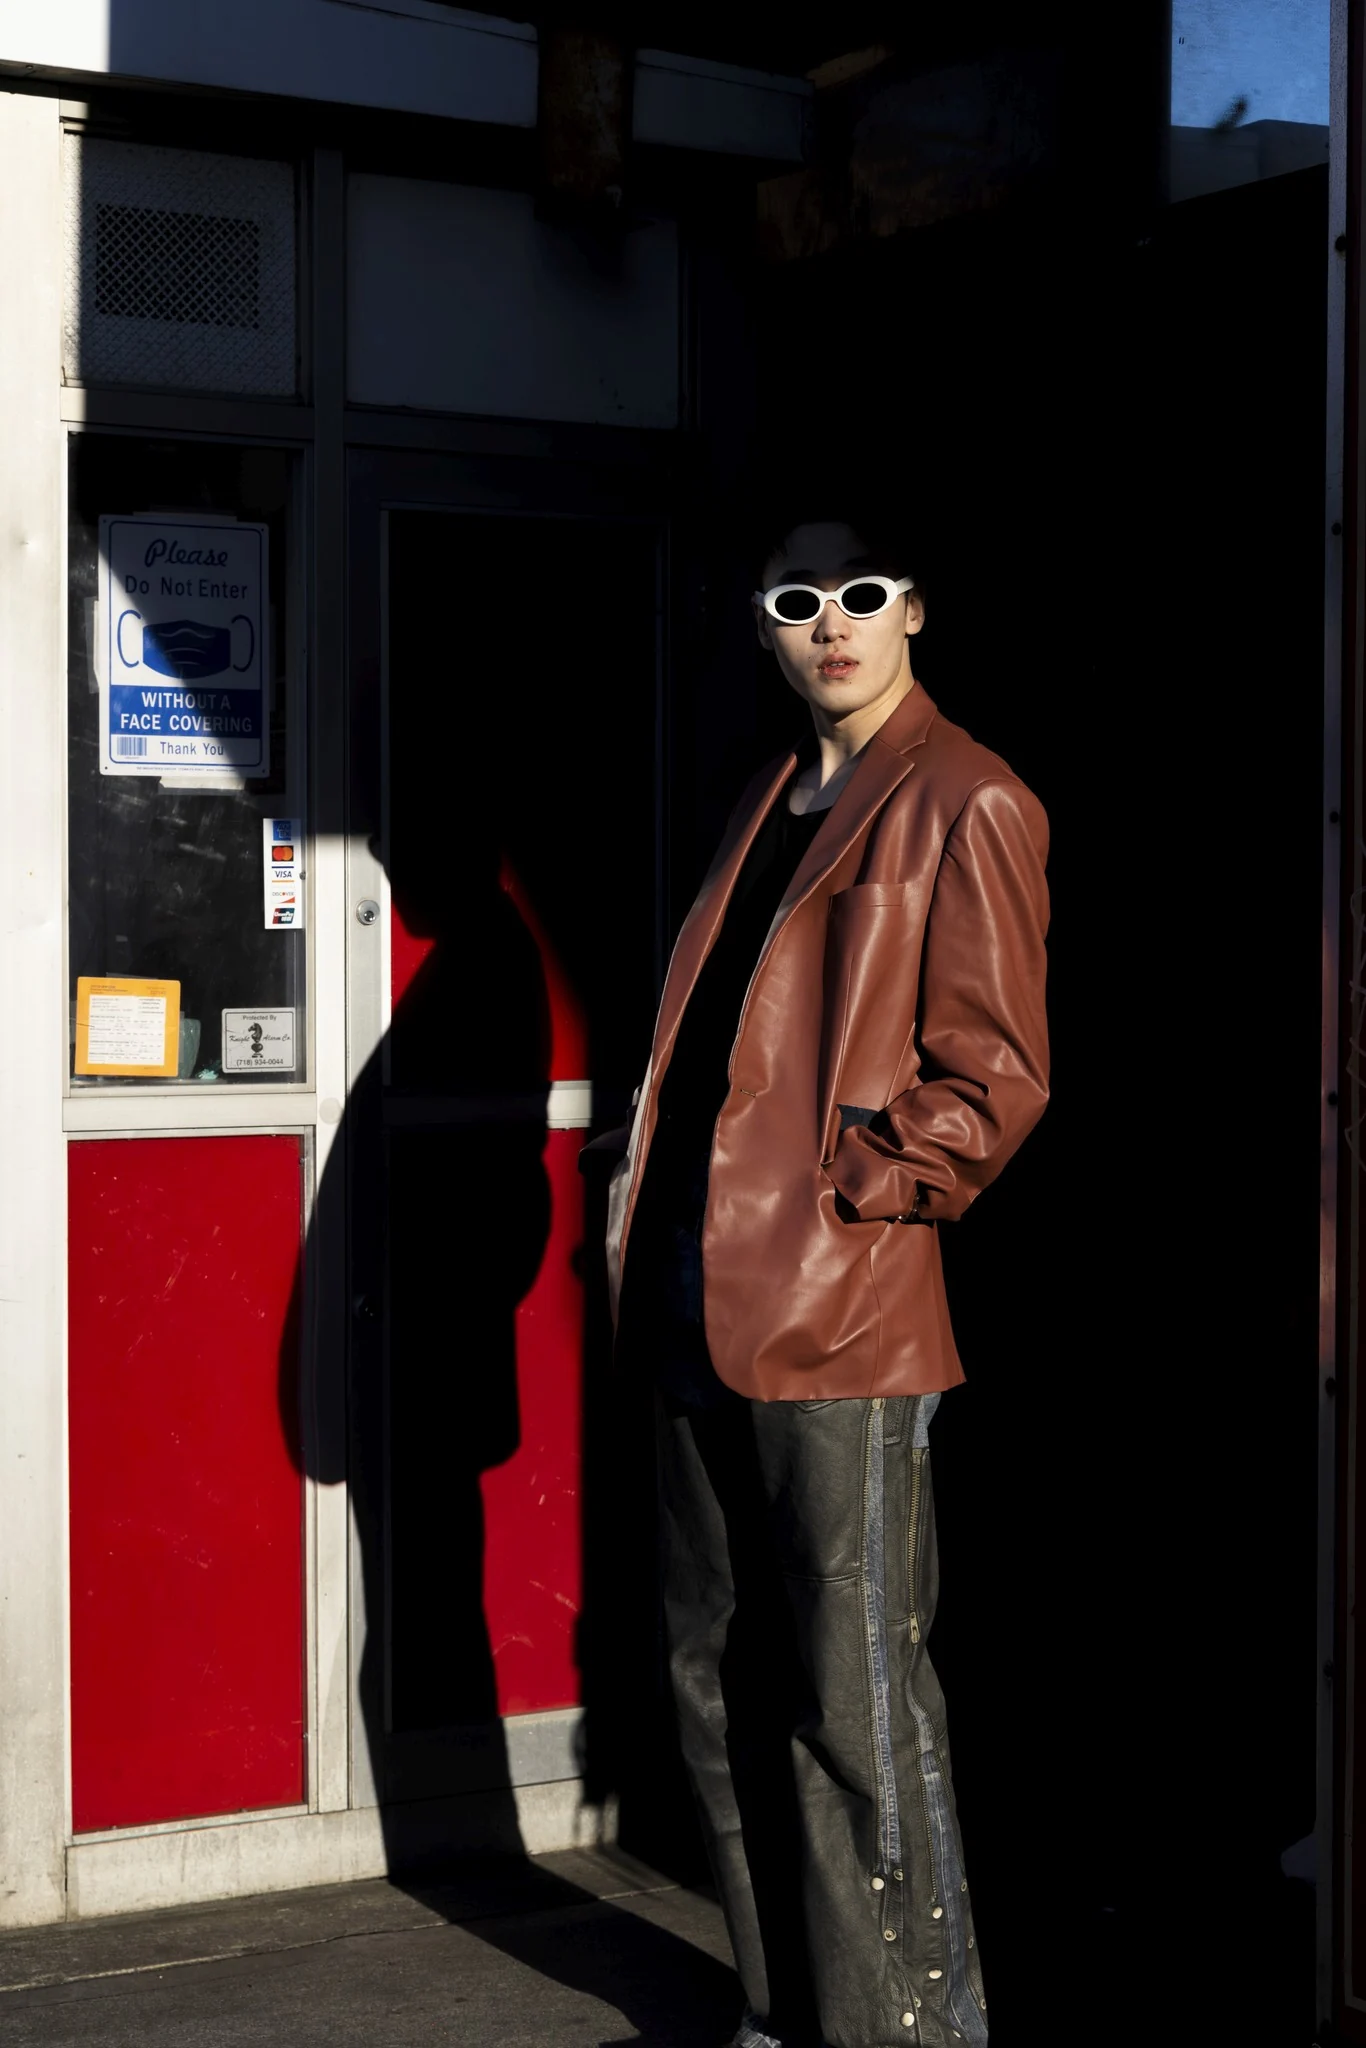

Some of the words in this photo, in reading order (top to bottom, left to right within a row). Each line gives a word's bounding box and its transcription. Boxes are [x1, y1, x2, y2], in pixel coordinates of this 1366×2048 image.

[144, 538, 229, 569] Please
[125, 575, 150, 595] Do
[161, 577, 193, 597] Not
[199, 579, 248, 599] Enter
[142, 692, 215, 710] WITHOUT
[221, 695, 231, 710] A
[120, 713, 161, 731] FACE
[169, 714, 252, 733] COVERING
[160, 741, 197, 755] Thank
[203, 743, 224, 756] You
[275, 870, 292, 878] VISA
[236, 1059, 253, 1067] (718)
